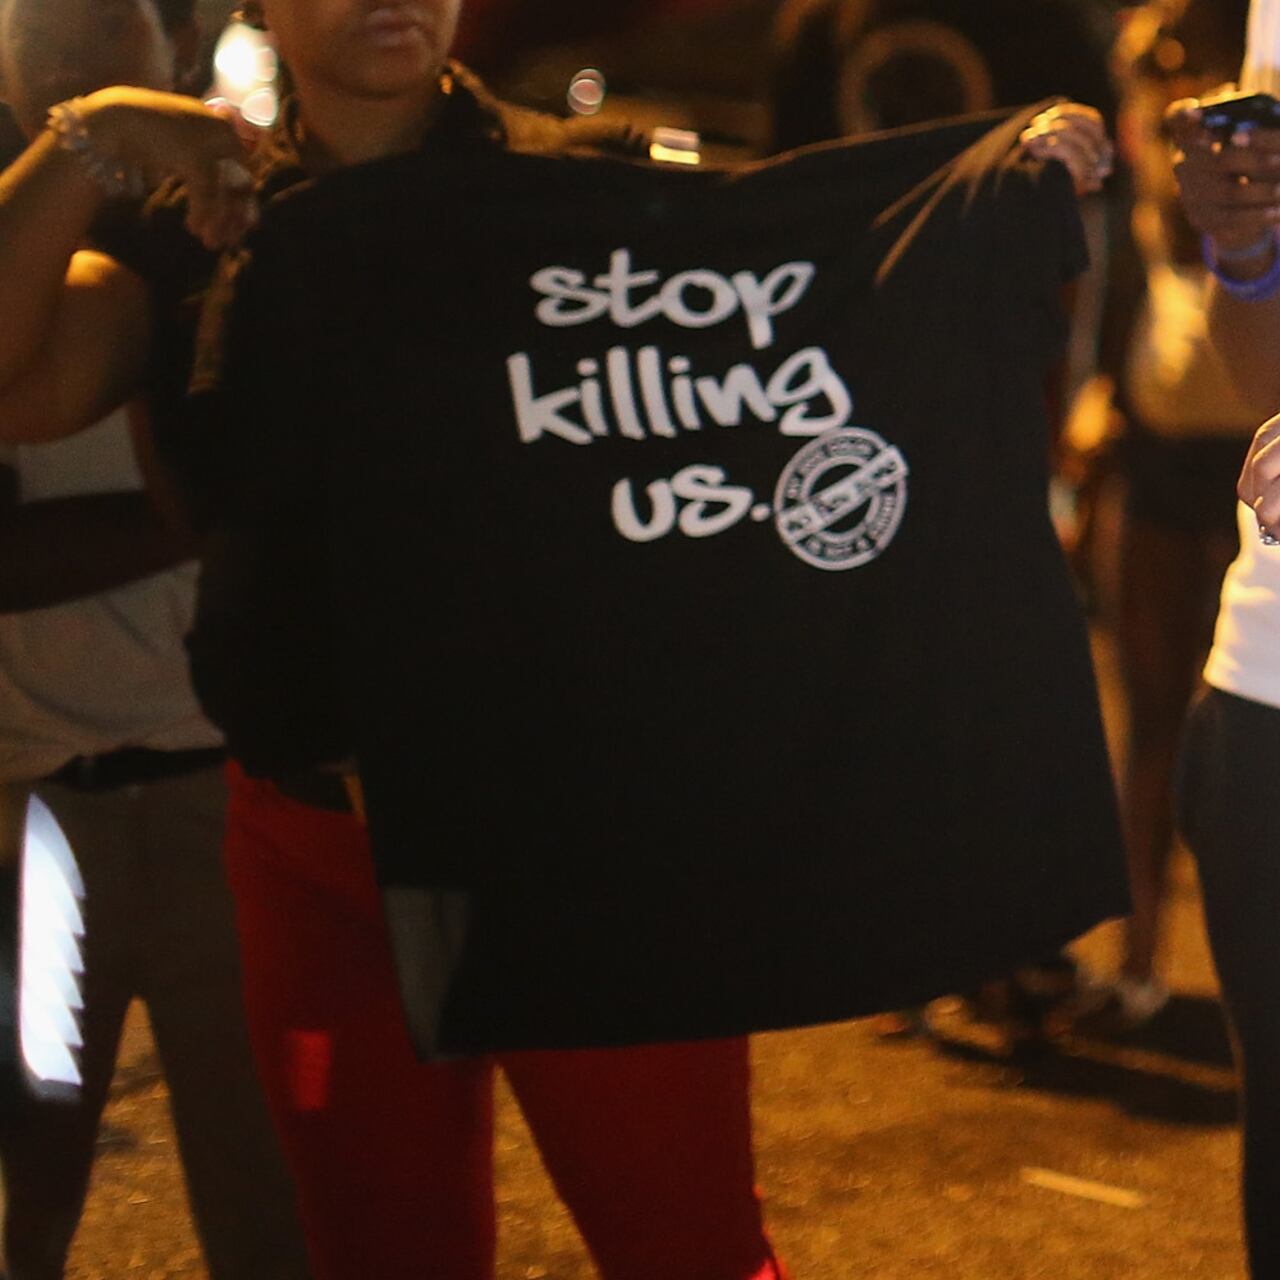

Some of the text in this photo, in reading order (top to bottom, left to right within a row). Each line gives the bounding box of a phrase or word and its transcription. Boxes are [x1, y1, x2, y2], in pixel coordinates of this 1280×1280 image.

[530, 248, 815, 349] stop
[506, 345, 854, 444] killing
[611, 464, 771, 543] us.
